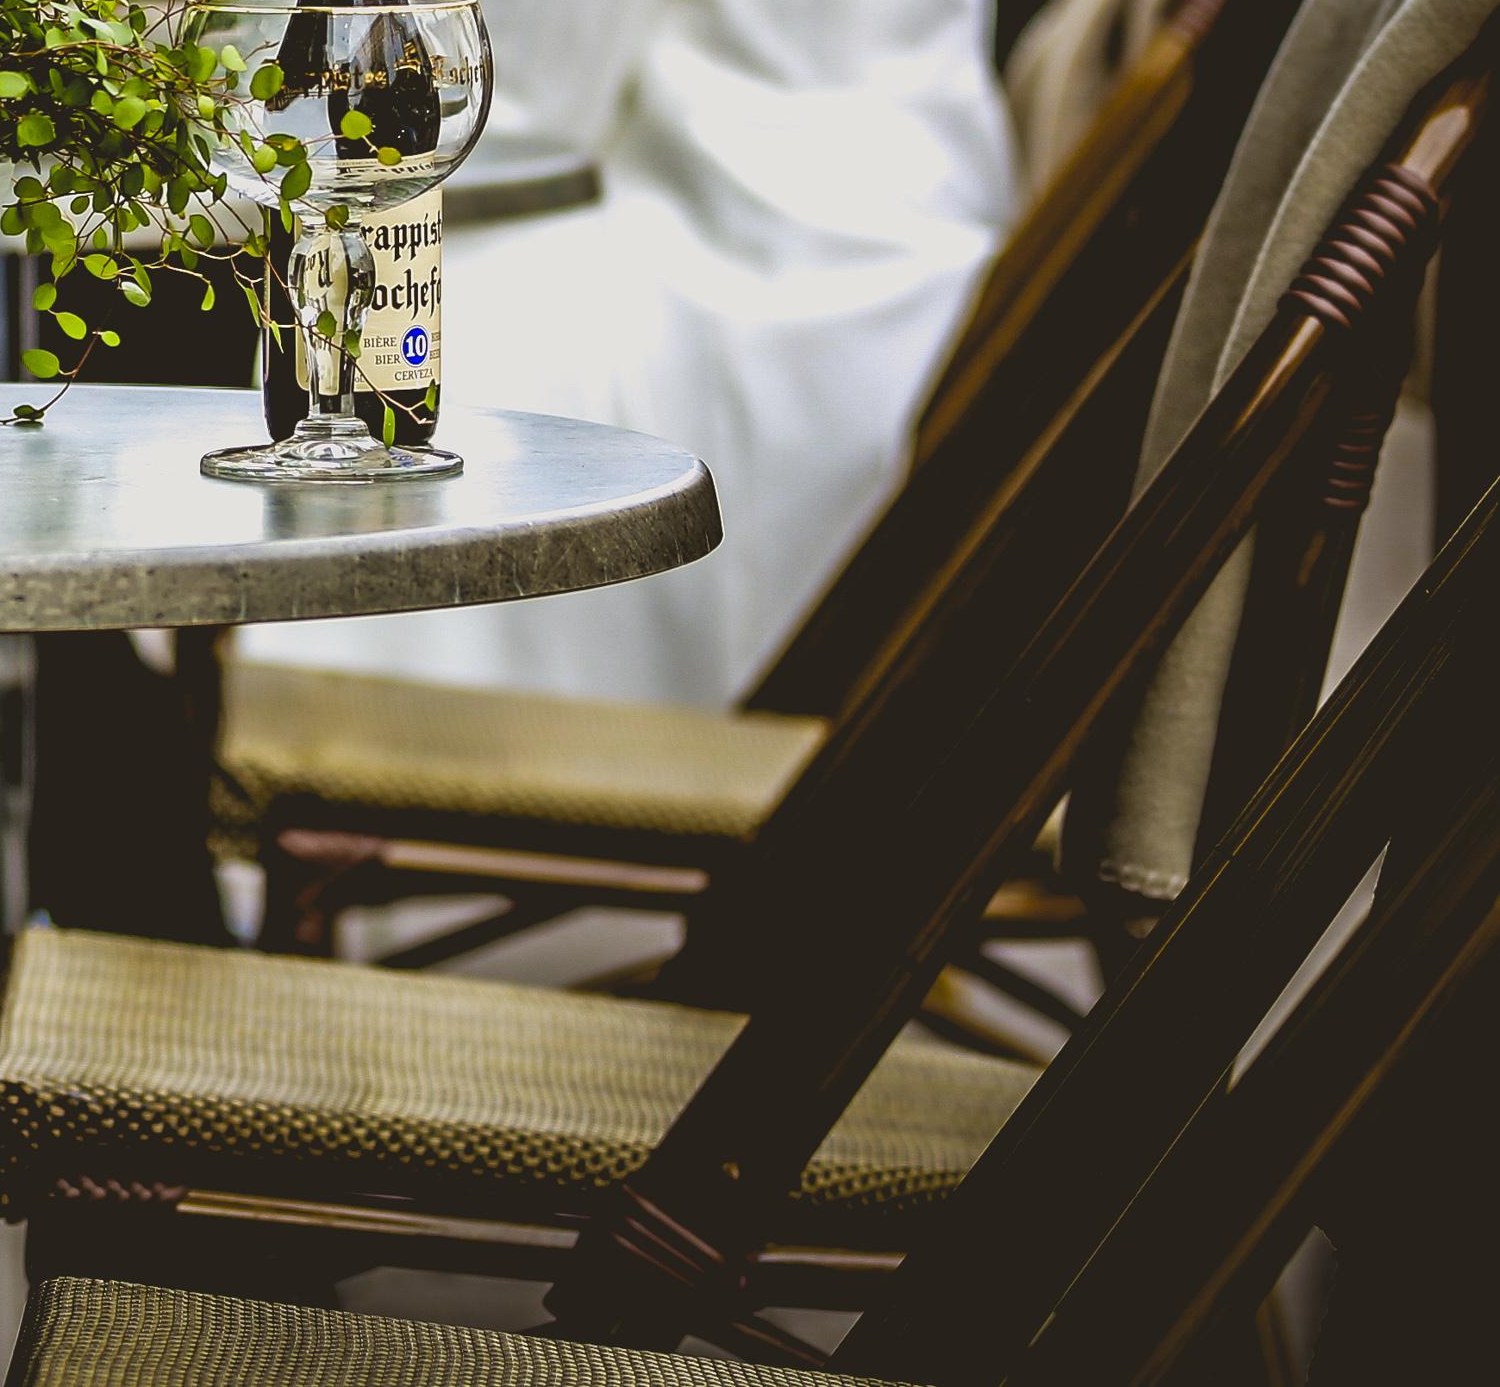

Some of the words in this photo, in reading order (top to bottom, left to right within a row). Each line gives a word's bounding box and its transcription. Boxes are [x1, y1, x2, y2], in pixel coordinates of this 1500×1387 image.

[361, 211, 441, 262] rappist
[371, 266, 441, 321] ochefo
[363, 335, 397, 348] BIÈRE
[405, 334, 426, 358] 10
[375, 354, 400, 365] BIER
[394, 368, 433, 382] CERVEZA
